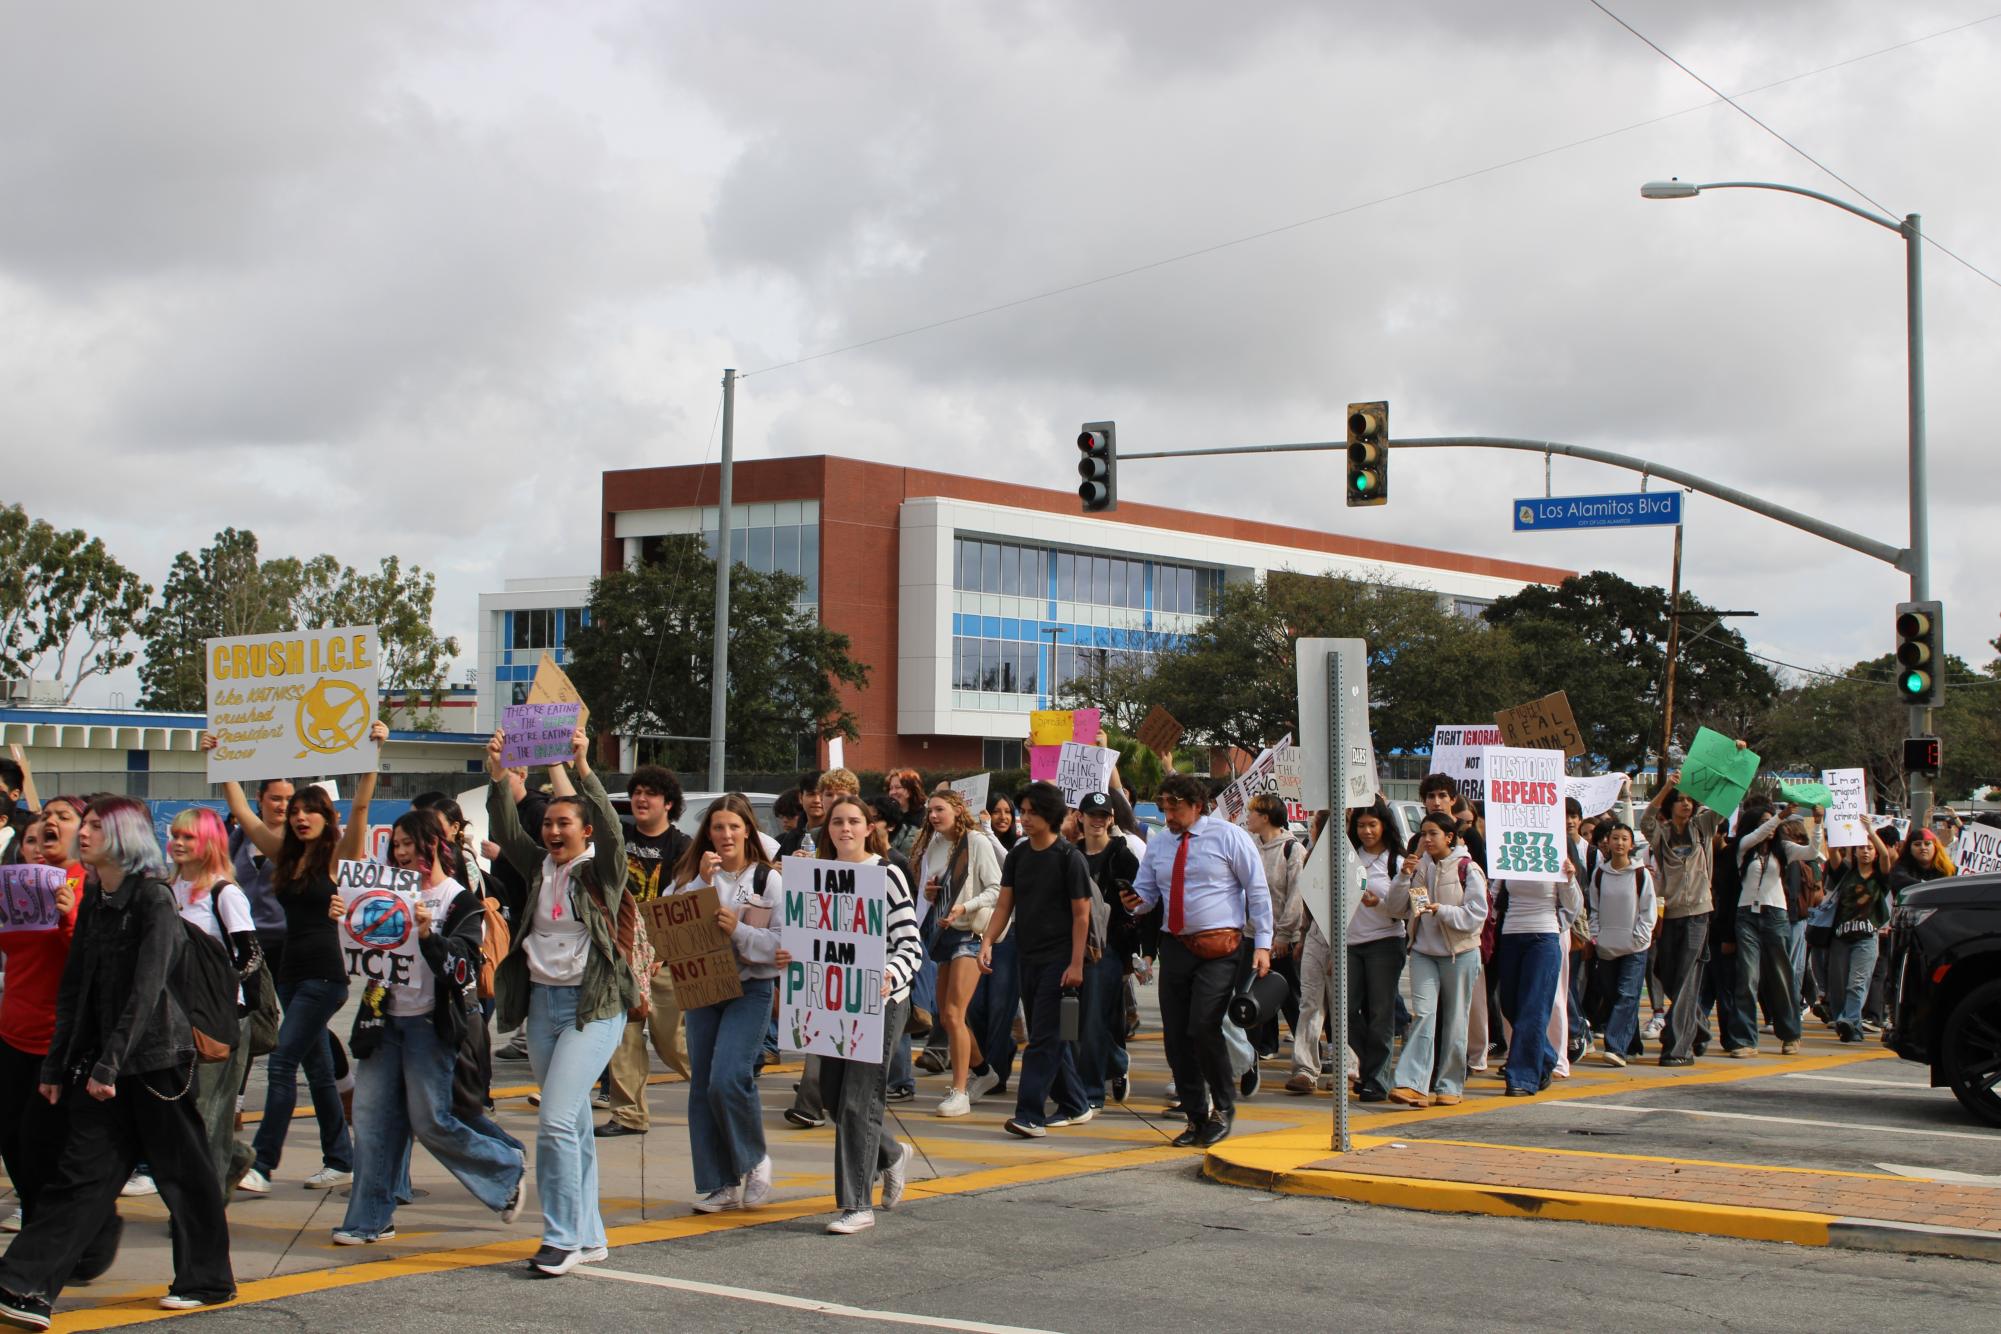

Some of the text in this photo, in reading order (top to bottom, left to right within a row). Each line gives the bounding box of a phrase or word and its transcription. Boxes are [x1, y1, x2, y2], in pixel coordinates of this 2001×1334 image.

[1539, 498, 1671, 519] Los Alamitos Blvd
[212, 634, 372, 680] CRUSH I.C.E.
[214, 684, 305, 706] like KATNISS
[214, 706, 276, 725] crushed
[547, 704, 579, 716] EATING
[215, 725, 284, 743] President
[521, 718, 536, 730] THE
[1508, 713, 1563, 740] REAL
[1436, 730, 1462, 746] FIGHT
[213, 746, 257, 761] Snow
[517, 746, 530, 759] THE
[1066, 743, 1090, 762] THE
[1060, 760, 1096, 778] THING
[1465, 757, 1480, 769] NOT
[1489, 755, 1558, 781] HISTORY
[1491, 779, 1558, 806] REPEATS
[1832, 800, 1845, 810] but
[1500, 804, 1551, 828] ITSELF
[1834, 811, 1858, 821] criminal
[1502, 831, 1553, 846] 1877
[1973, 831, 1996, 856] YOU
[1498, 845, 1558, 860] 1939
[1960, 850, 1979, 870] MY
[1496, 858, 1560, 873] 2026
[336, 861, 422, 892] ABOLISH
[813, 867, 856, 895] I AM
[652, 895, 701, 929] FIGHT
[785, 890, 883, 936] MEXICAN
[813, 939, 856, 965] I AM
[344, 947, 415, 985] ICE
[669, 958, 707, 983] NOT
[786, 960, 882, 1015] PROUD
